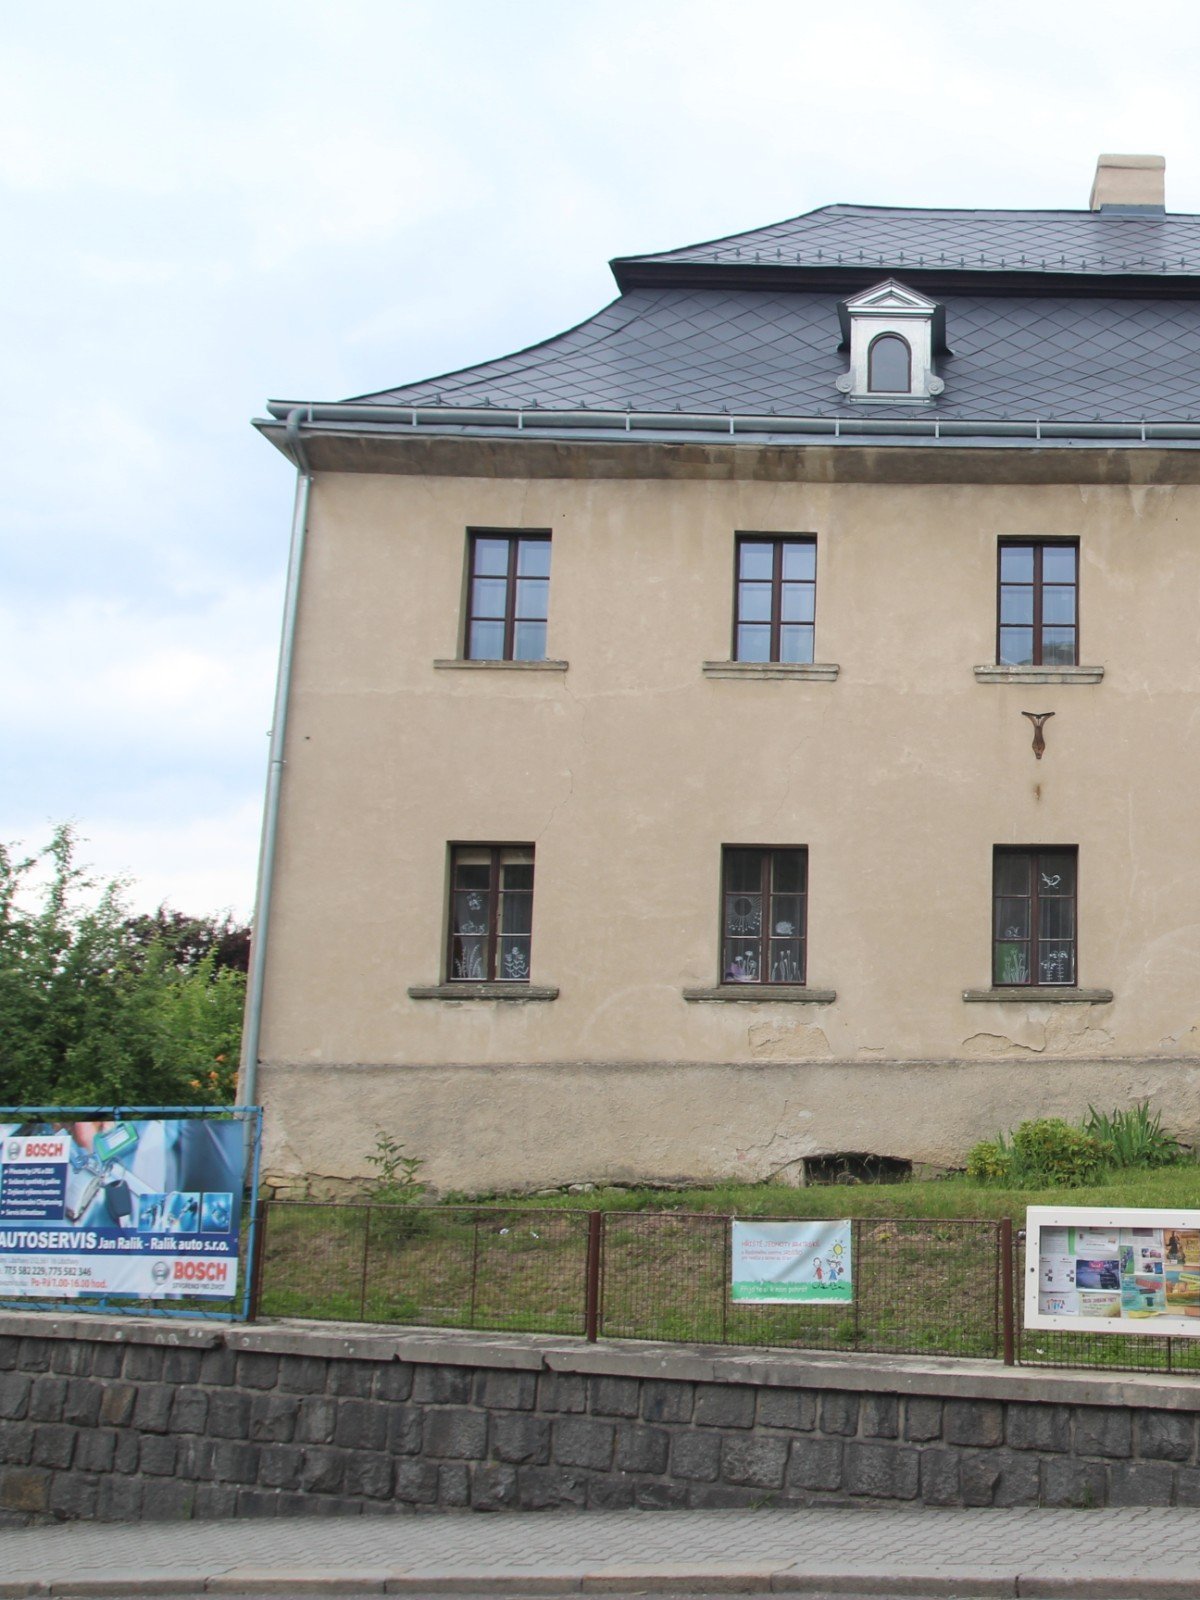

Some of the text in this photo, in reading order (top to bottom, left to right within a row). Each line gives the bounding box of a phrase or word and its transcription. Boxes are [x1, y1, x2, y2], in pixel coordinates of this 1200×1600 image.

[25, 1143, 64, 1158] BOSCH
[0, 1231, 97, 1249] AUTOSERVIS
[98, 1237, 116, 1250] Jan
[177, 1239, 203, 1251] auto
[204, 1239, 230, 1251] s.r.o.
[173, 1261, 227, 1281] BOSCH
